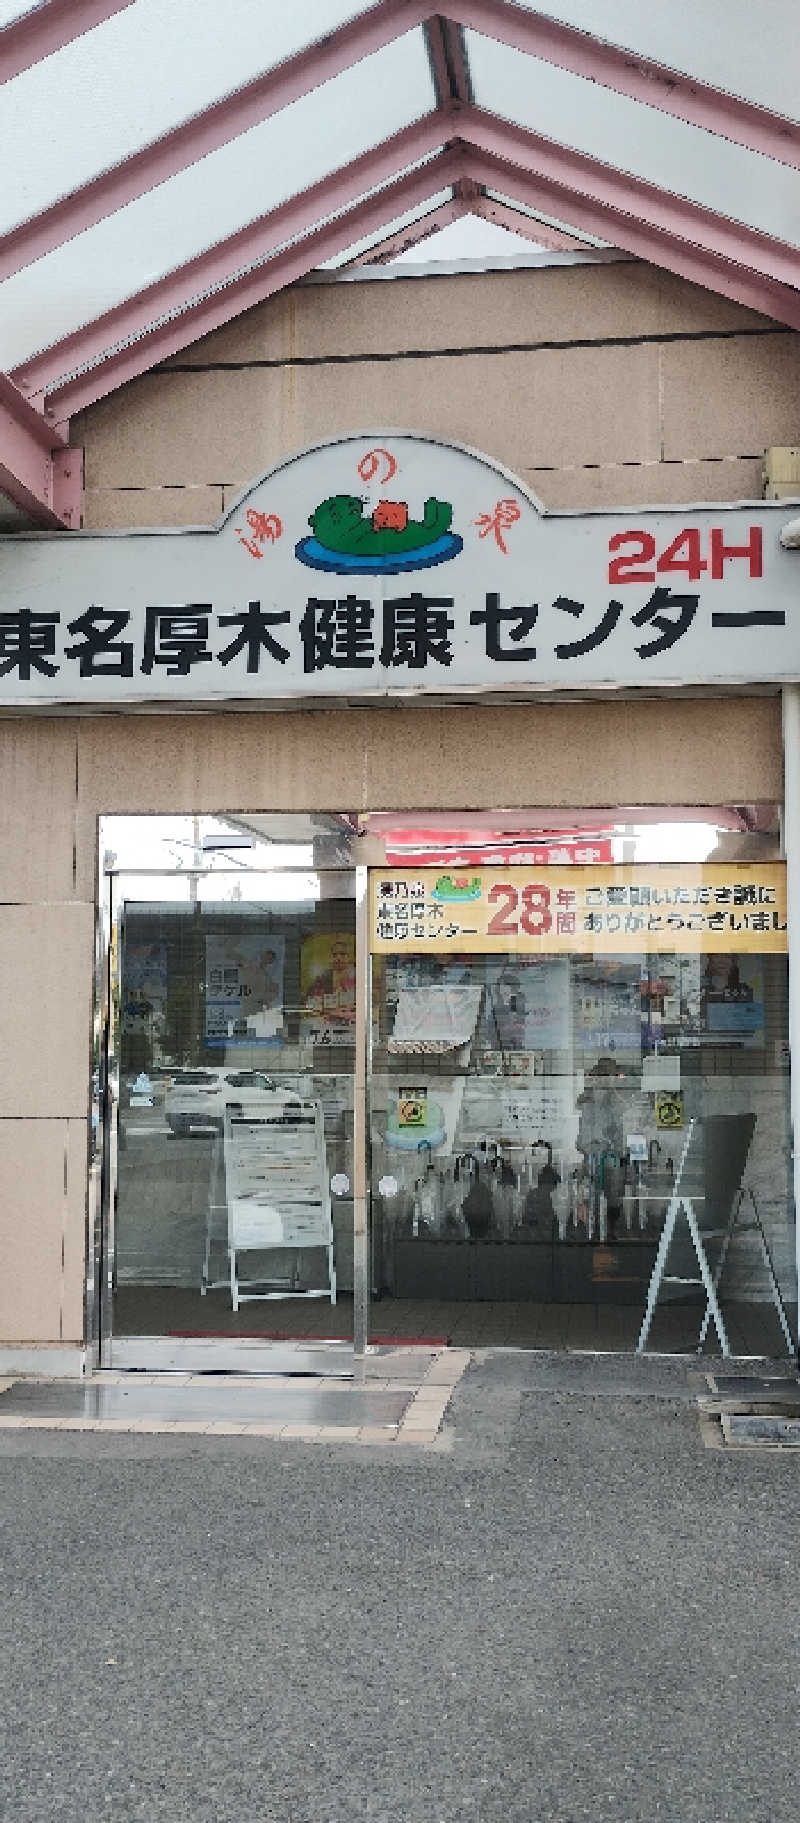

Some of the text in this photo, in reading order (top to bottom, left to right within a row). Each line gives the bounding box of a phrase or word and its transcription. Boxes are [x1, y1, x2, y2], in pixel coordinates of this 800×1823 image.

[608, 527, 763, 584] 24H
[0, 587, 786, 680] 東名厚木健康センター
[487, 885, 552, 935] 28
